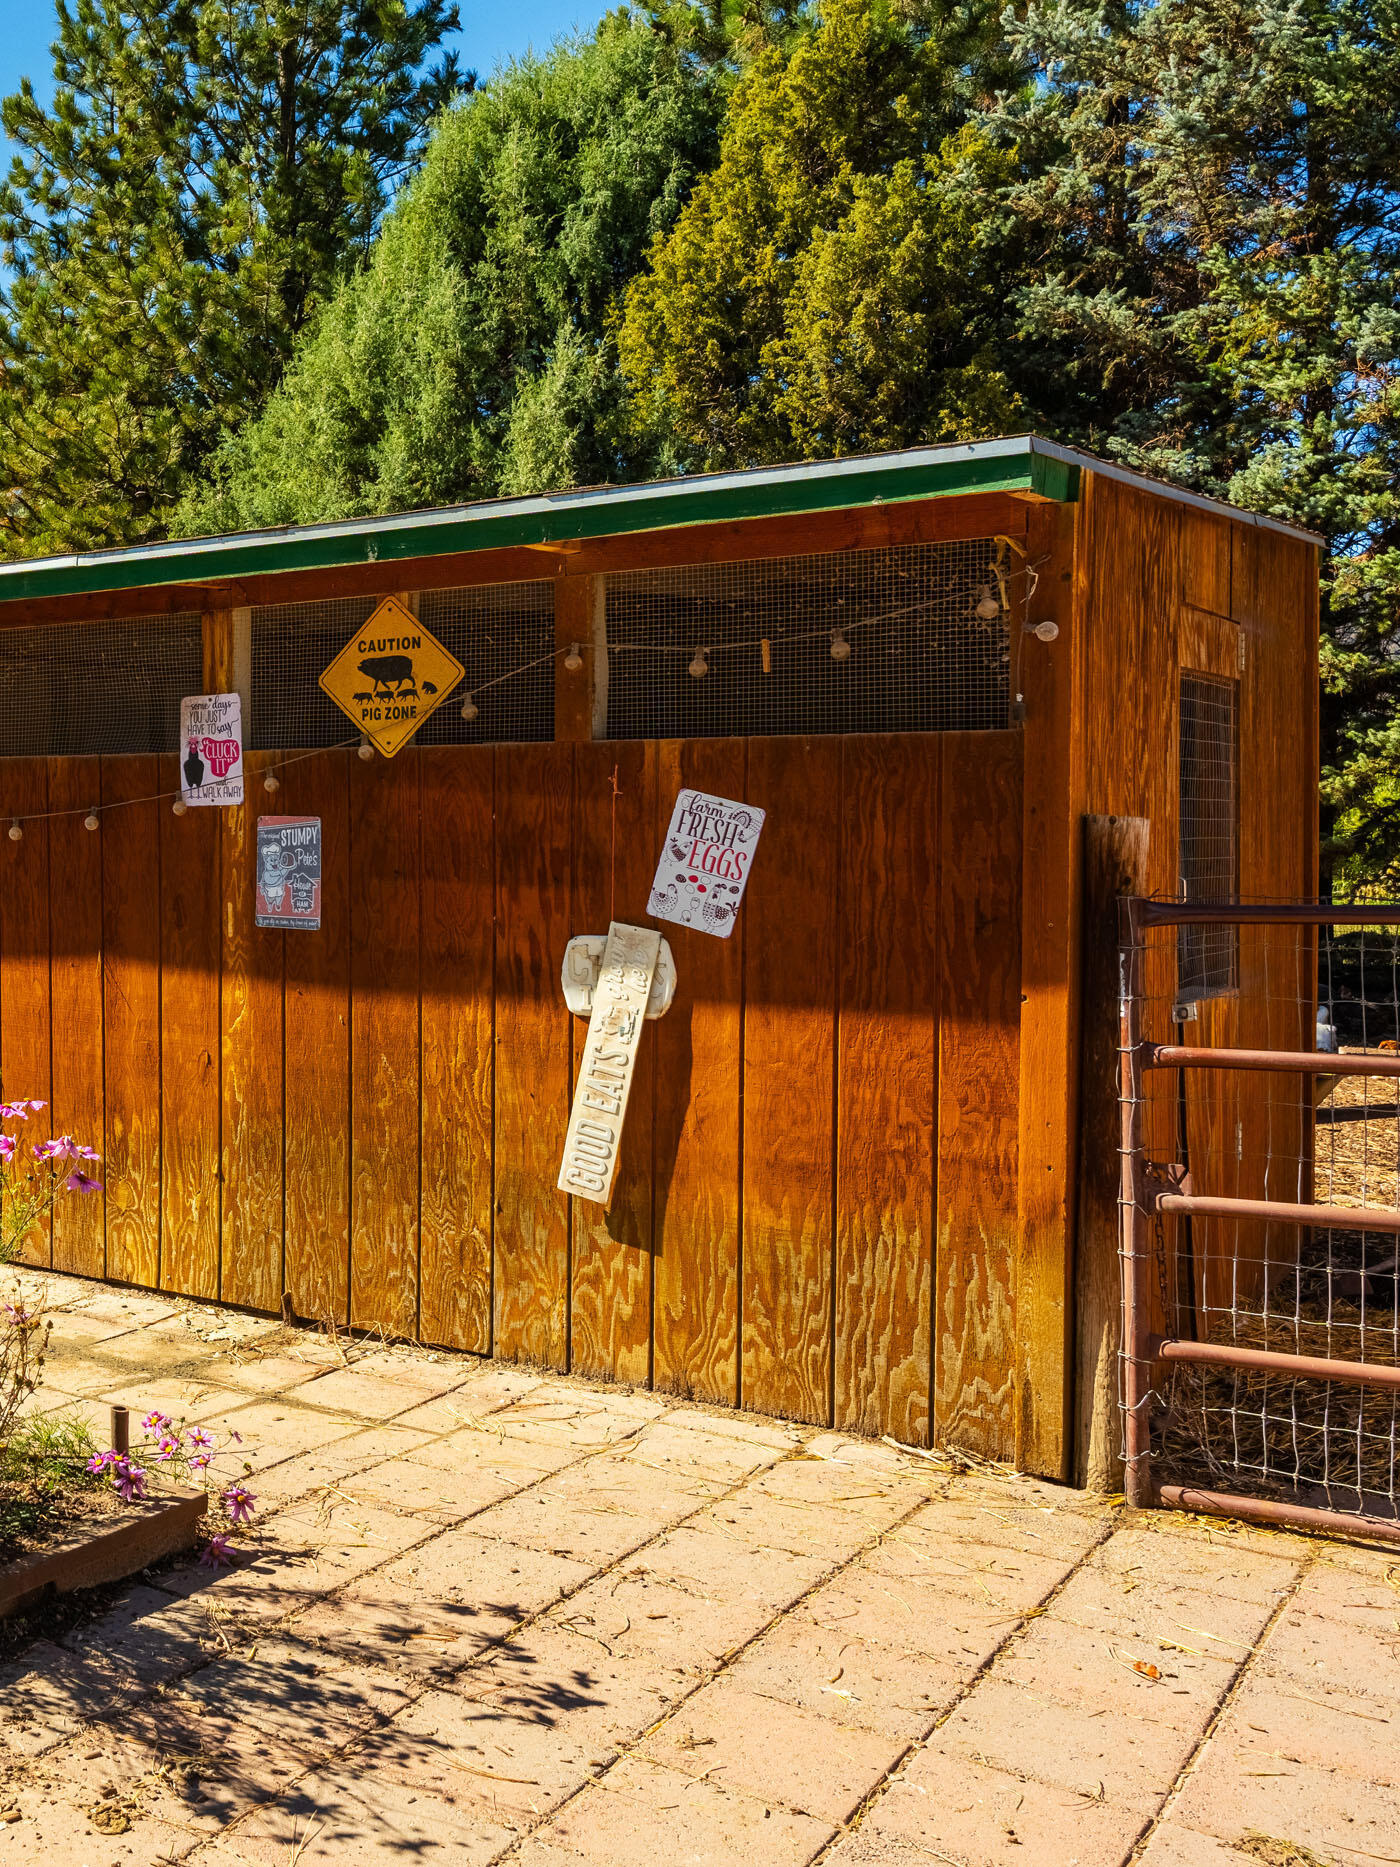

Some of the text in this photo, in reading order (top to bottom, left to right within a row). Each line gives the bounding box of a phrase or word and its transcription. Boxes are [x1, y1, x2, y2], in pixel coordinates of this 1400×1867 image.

[358, 636, 421, 653] CAUTION
[211, 696, 232, 715] days
[362, 706, 417, 721] PIG ZONE
[189, 710, 221, 723] YOU JUST
[188, 722, 233, 738] HAVE TO say
[202, 785, 242, 798] WALK AWAY
[281, 827, 318, 847] STUMPY
[676, 809, 739, 848] FRESH
[295, 848, 318, 866] Pete's
[687, 839, 747, 881] EGGS
[581, 1045, 629, 1117] EATS
[566, 1118, 615, 1193] GOOD
